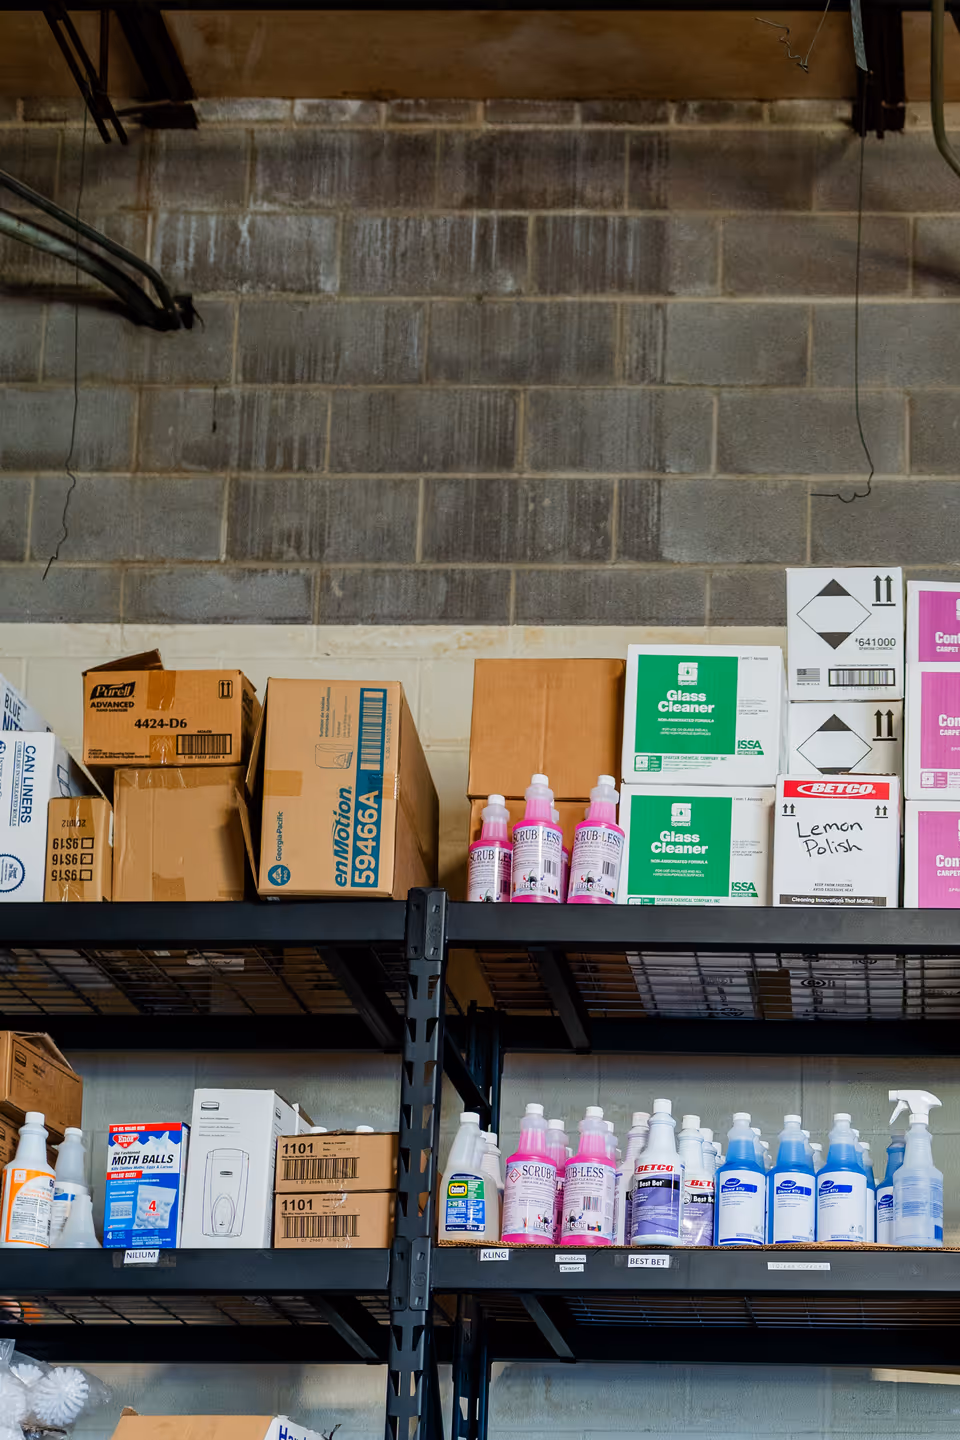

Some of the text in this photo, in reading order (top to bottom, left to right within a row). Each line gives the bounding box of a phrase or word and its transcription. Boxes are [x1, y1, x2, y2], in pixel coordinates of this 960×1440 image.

[666, 690, 707, 702] Glass
[4, 693, 21, 722] BLUE
[657, 701, 715, 714] Cleaner
[134, 718, 188, 729] 4424-D6
[737, 740, 762, 750] ISSA
[20, 746, 36, 824] CAN LINERS
[811, 783, 874, 794] BETCO
[276, 811, 284, 861] Georgia-Pacific
[796, 822, 862, 838] Lemon
[354, 790, 380, 885] 59466A
[660, 830, 700, 843] Glass
[52, 838, 79, 850] 9S19
[650, 842, 708, 854] Cleaner
[803, 838, 862, 857] Polish
[52, 853, 78, 865] 9S16
[51, 869, 77, 881] 9S15
[732, 882, 756, 892] ISSA
[792, 896, 814, 904] Cleaning
[282, 1143, 314, 1154] 1101
[112, 1154, 174, 1166] MOTH BALLS
[636, 1164, 674, 1172] BETCO
[148, 1200, 156, 1212] 4
[282, 1199, 312, 1210] 1101
[107, 1232, 112, 1240] 4
[126, 1251, 156, 1260] NILIUM
[651, 1258, 666, 1266] BET
